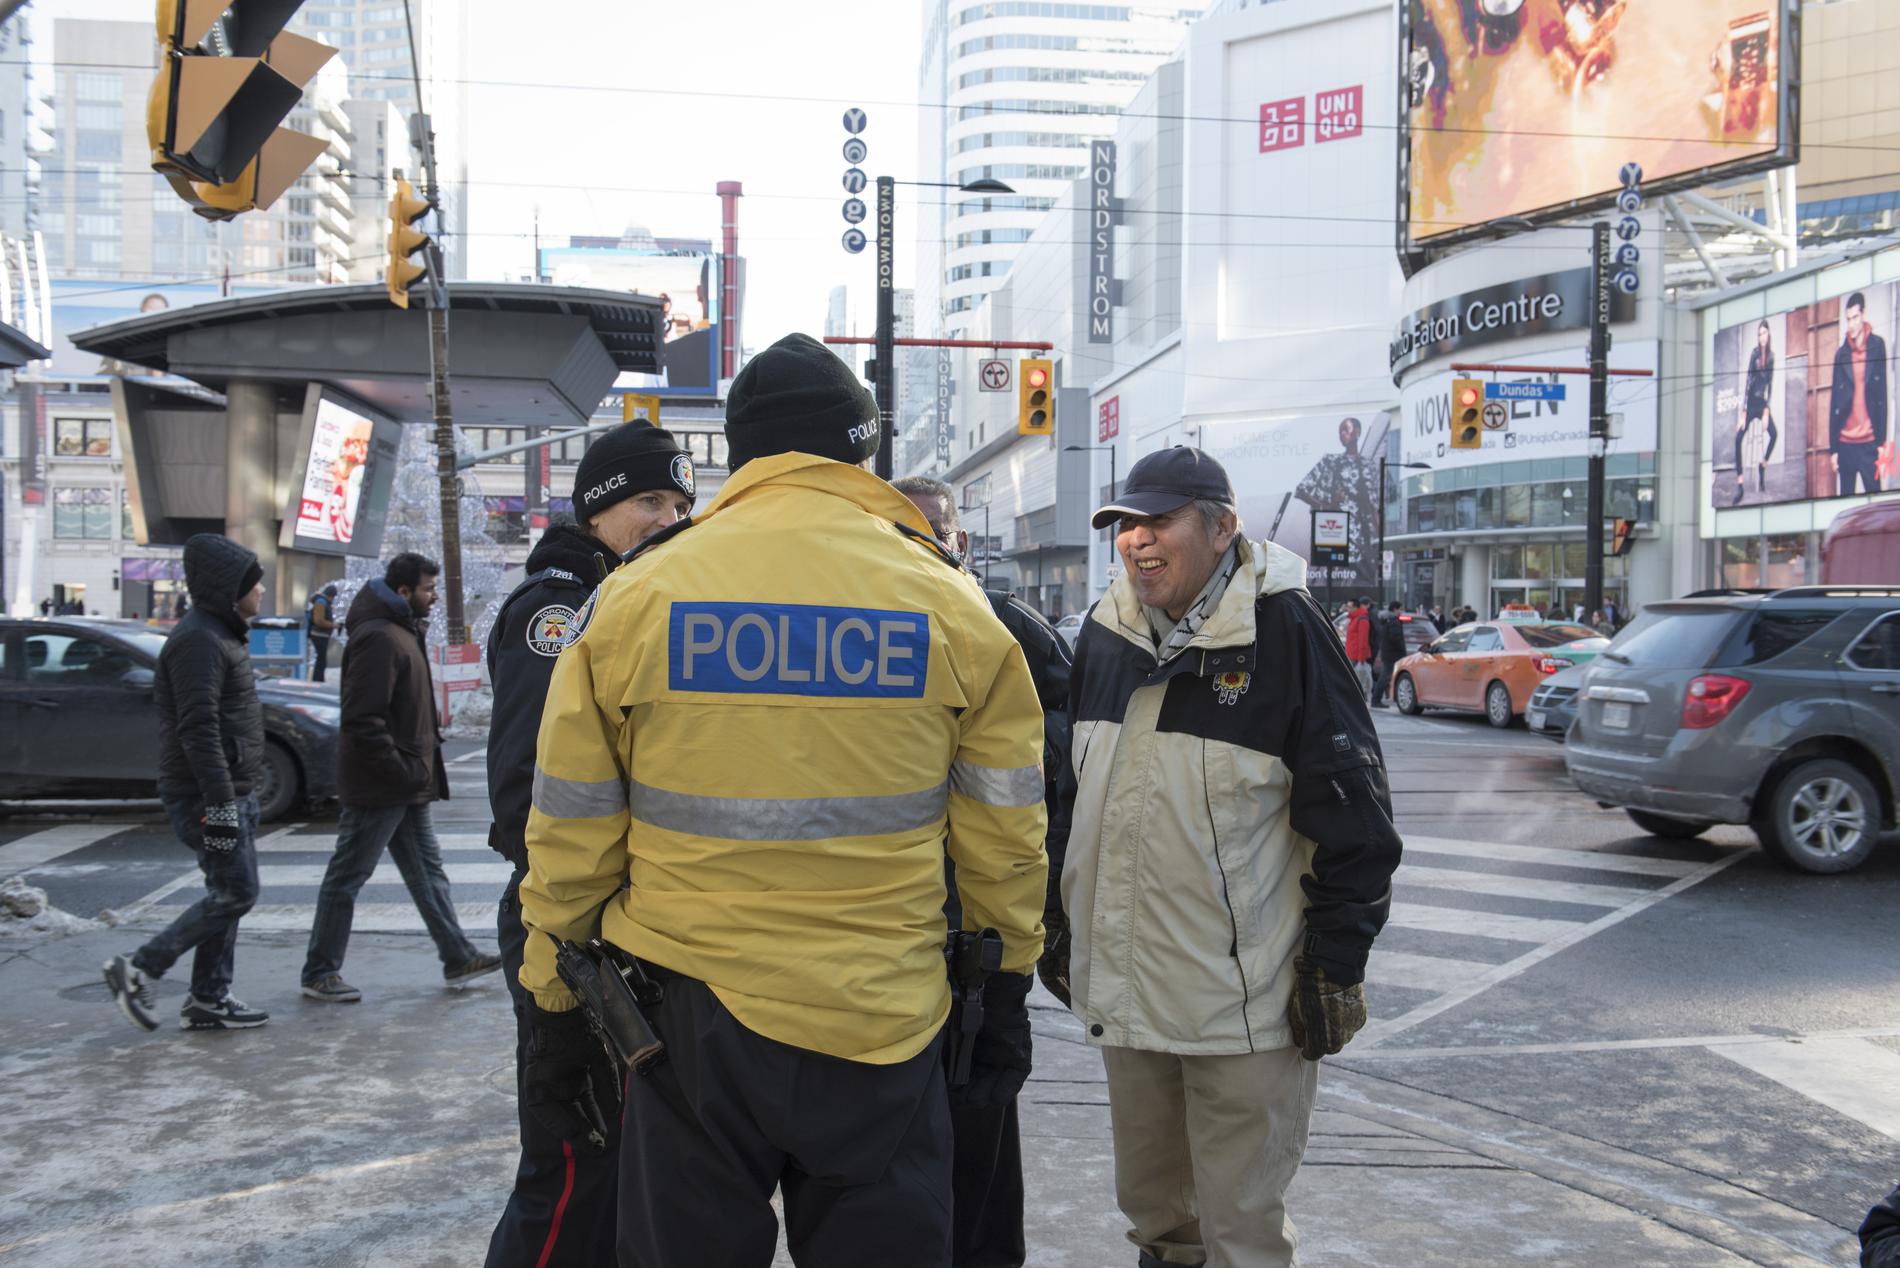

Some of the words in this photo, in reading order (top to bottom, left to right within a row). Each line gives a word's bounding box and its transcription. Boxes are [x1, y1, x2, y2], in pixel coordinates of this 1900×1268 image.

[1319, 91, 1355, 116] UNI
[1319, 112, 1357, 138] QLO
[880, 185, 891, 288] DOWNTOWN
[1093, 146, 1111, 336] NORDSTROM
[1599, 230, 1609, 323] DOWNTOWN
[1412, 314, 1459, 349] Eaton
[1466, 292, 1561, 332] Centre
[938, 350, 949, 457] NORDSTROM
[1499, 384, 1544, 397] Dundas
[1271, 443, 1312, 458] STYLE
[583, 473, 628, 505] POLICE
[1107, 569, 1119, 578] 40
[536, 641, 562, 653] POLIC
[682, 612, 917, 687] POLICE
